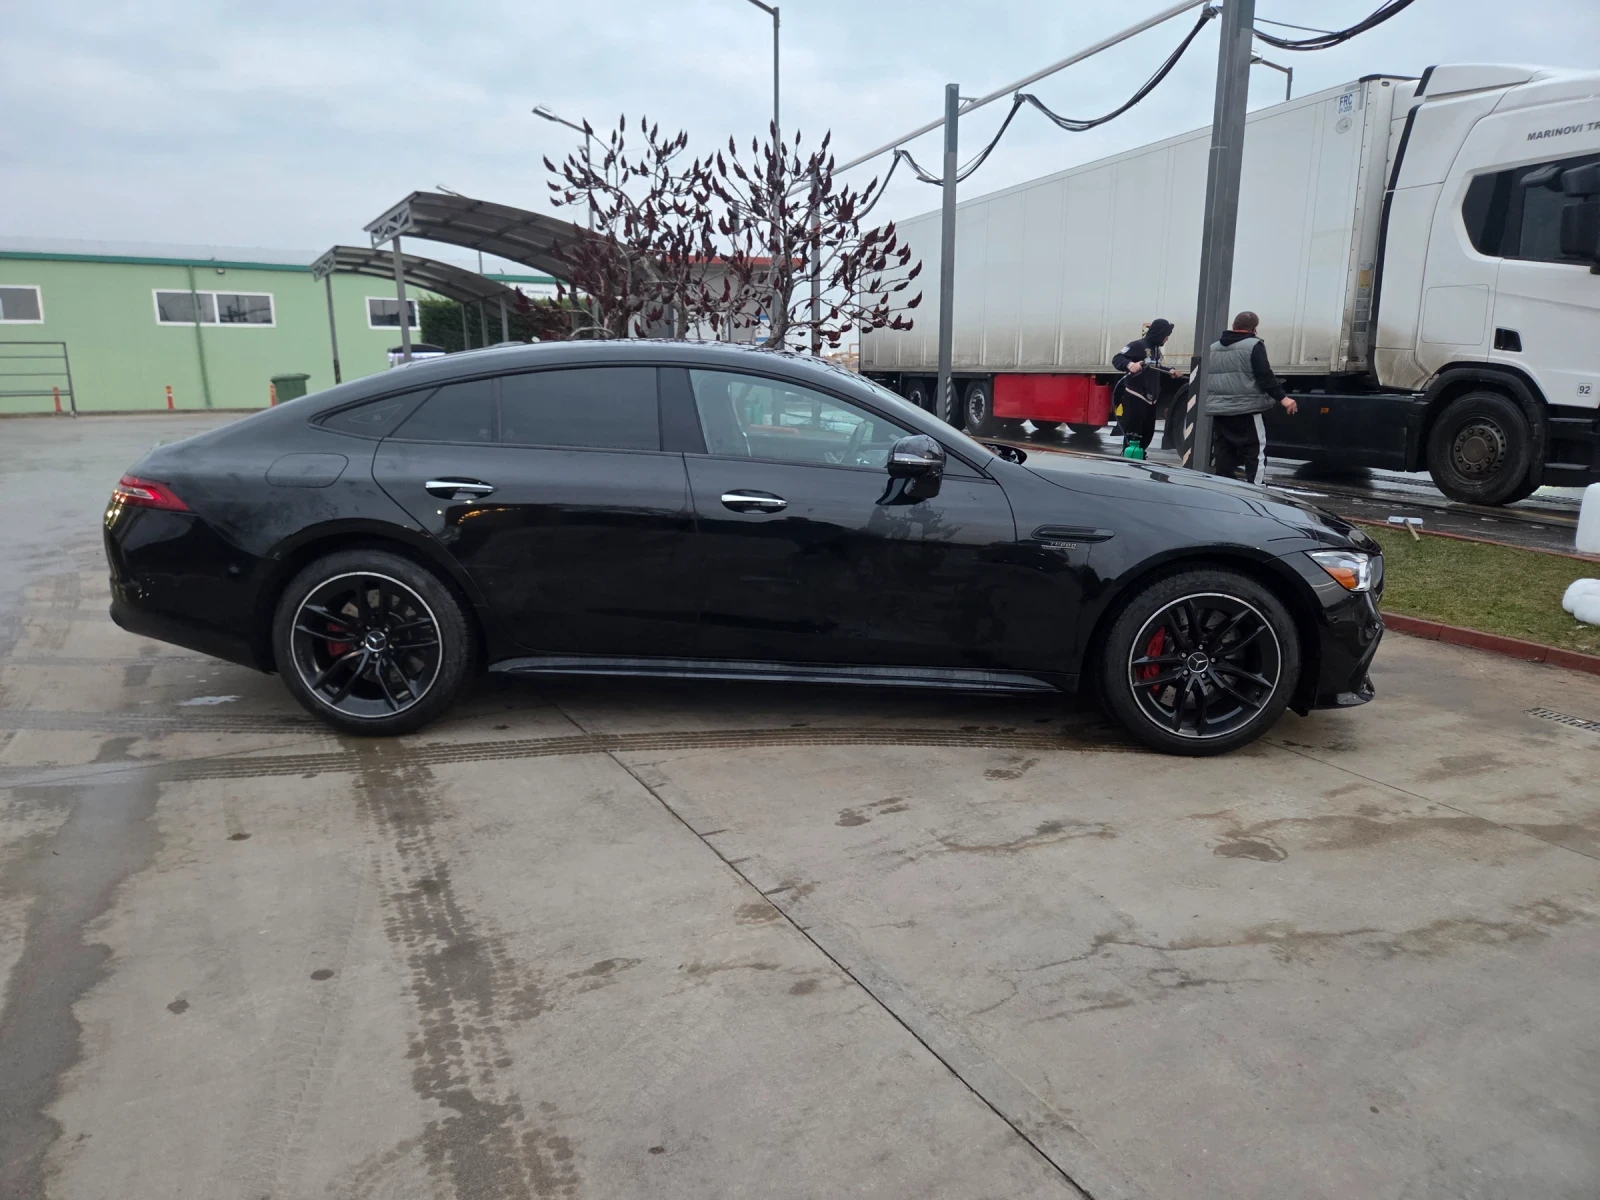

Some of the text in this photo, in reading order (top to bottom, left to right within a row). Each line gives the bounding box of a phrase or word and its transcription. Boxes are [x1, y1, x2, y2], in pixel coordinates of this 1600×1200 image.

[1339, 93, 1353, 107] FRC
[1527, 123, 1584, 141] MARINOVI
[1578, 385, 1591, 395] 92
